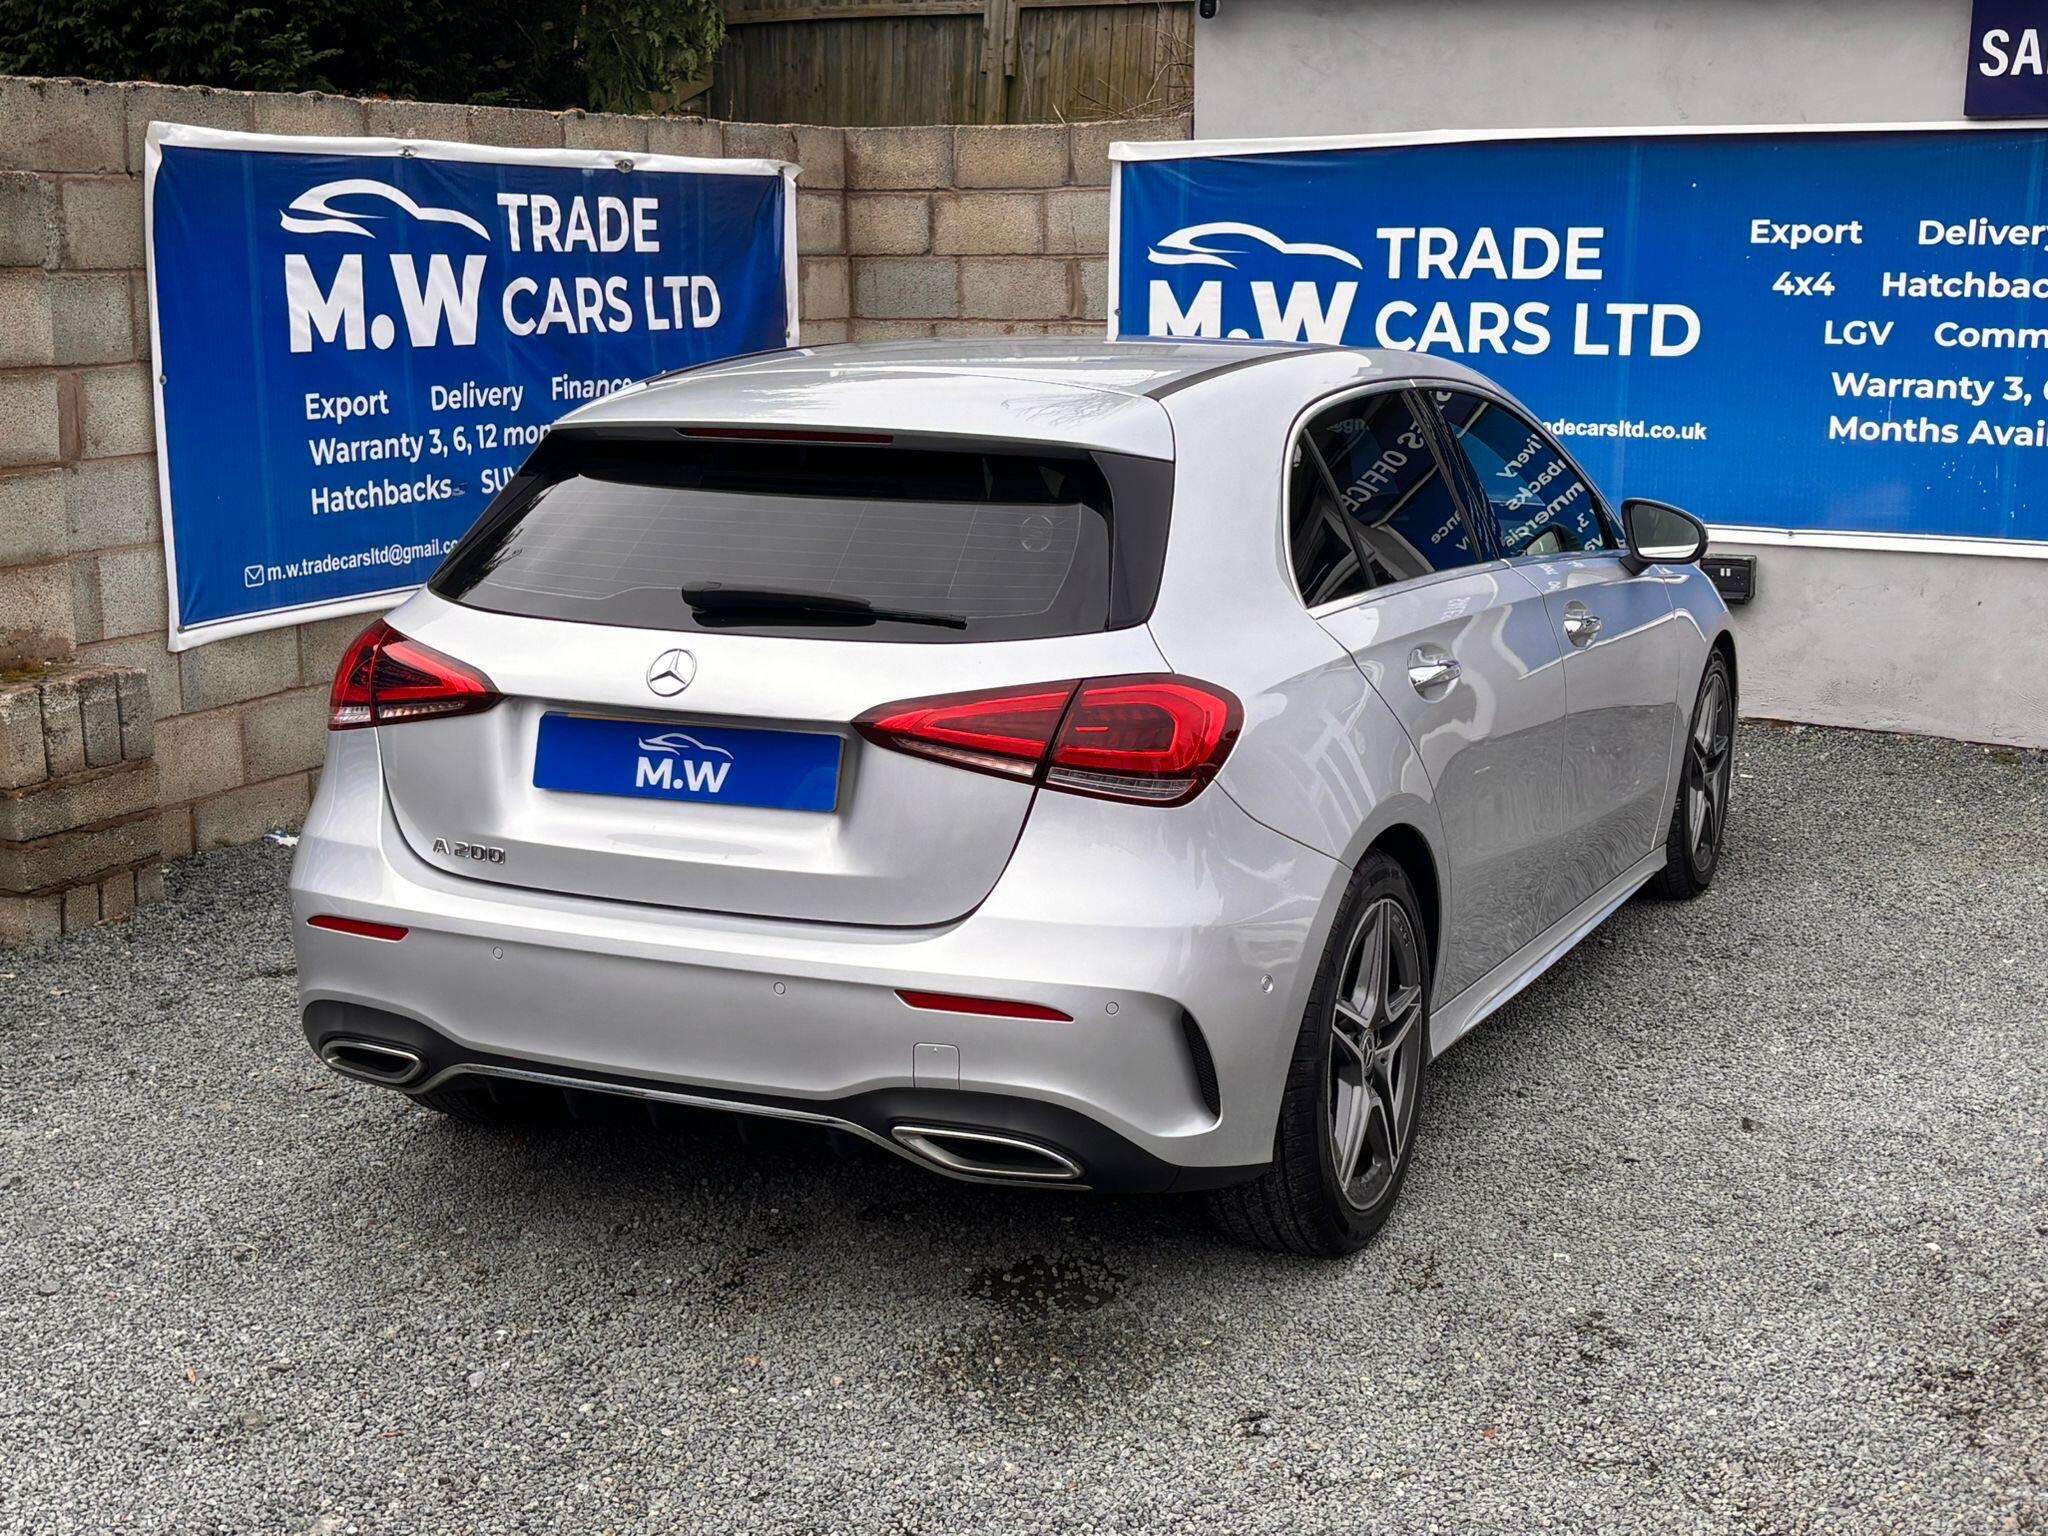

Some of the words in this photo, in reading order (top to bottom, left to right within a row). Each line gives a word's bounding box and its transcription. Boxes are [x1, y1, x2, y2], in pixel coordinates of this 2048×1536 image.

[1979, 28, 2048, 77] SA
[497, 193, 660, 252] TRADE
[1750, 218, 1863, 250] Export
[1376, 226, 1605, 280] TRADE
[285, 254, 487, 353] M.W
[502, 276, 633, 337] CARS
[644, 275, 722, 331] LTD
[1771, 271, 1836, 296] 4x4
[1882, 271, 2048, 299] Hatchbac
[1375, 301, 1552, 354] CARS
[1573, 303, 1701, 356] LTD
[1824, 320, 1895, 346] LGV
[1934, 322, 2048, 349] Comm
[305, 389, 390, 424] Export
[431, 380, 524, 412] Delivery
[1831, 371, 1996, 406] Warranty
[2002, 376, 2032, 407] 3,
[309, 432, 424, 466] Warranty
[429, 428, 449, 458] 3,
[452, 426, 473, 456] 6,
[476, 423, 498, 449] 12
[1828, 415, 1959, 444] Months
[1967, 419, 2048, 447] Avai
[312, 472, 453, 515] Hatchbacks
[634, 756, 733, 794] M.W
[432, 837, 451, 856] A
[454, 841, 506, 866] 200
